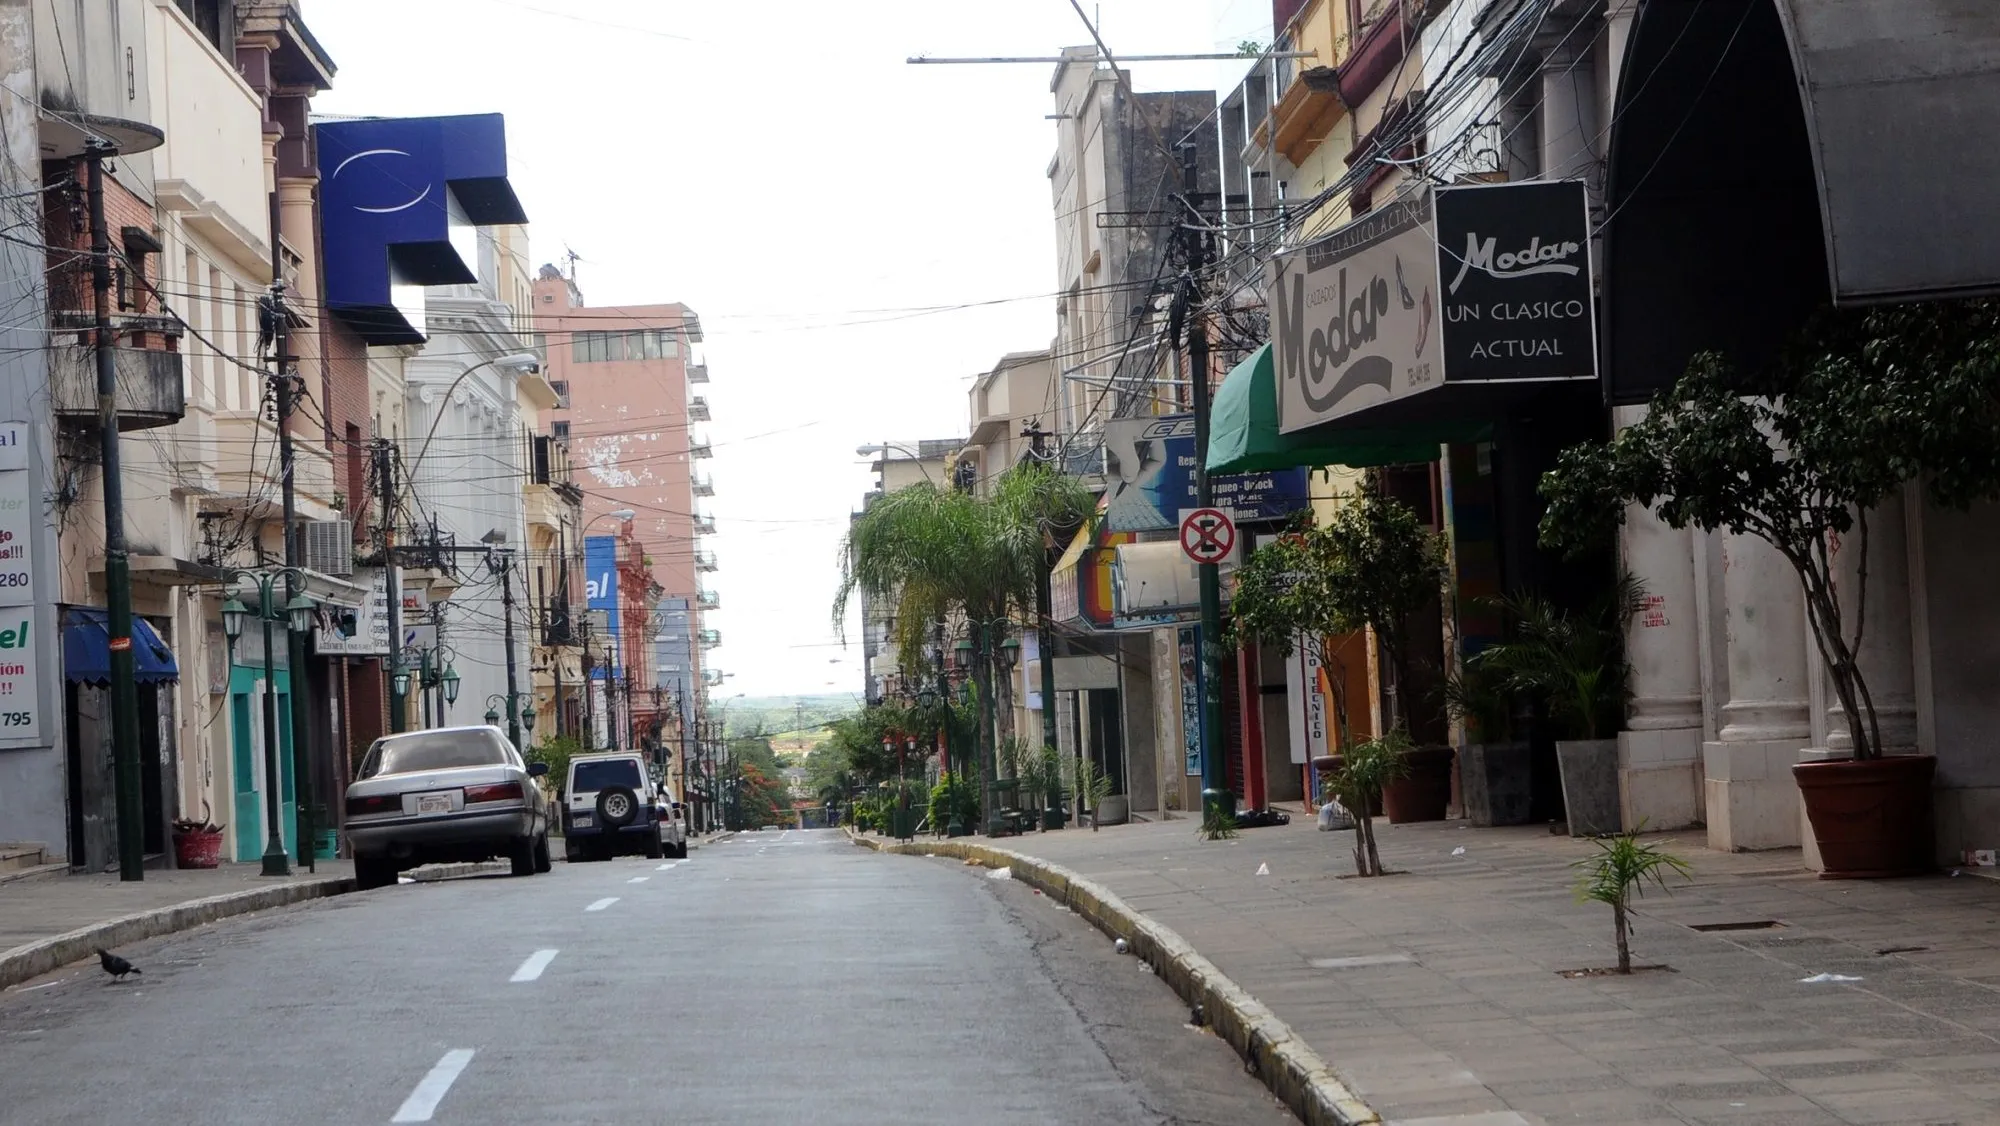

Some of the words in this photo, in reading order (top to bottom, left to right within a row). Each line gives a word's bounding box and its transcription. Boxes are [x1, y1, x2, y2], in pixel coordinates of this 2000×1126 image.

[1311, 247, 1326, 264] UN
[1330, 221, 1375, 256] CLASICO
[1448, 232, 1579, 296] Modar
[1306, 283, 1337, 309] CALZADOS
[1446, 303, 1480, 322] UN
[1490, 300, 1583, 320] CLASICO
[1274, 258, 1392, 428] Modar
[1470, 338, 1564, 359] ACTUAL
[2, 712, 31, 726] 795
[1310, 676, 1322, 739] TECNICO
